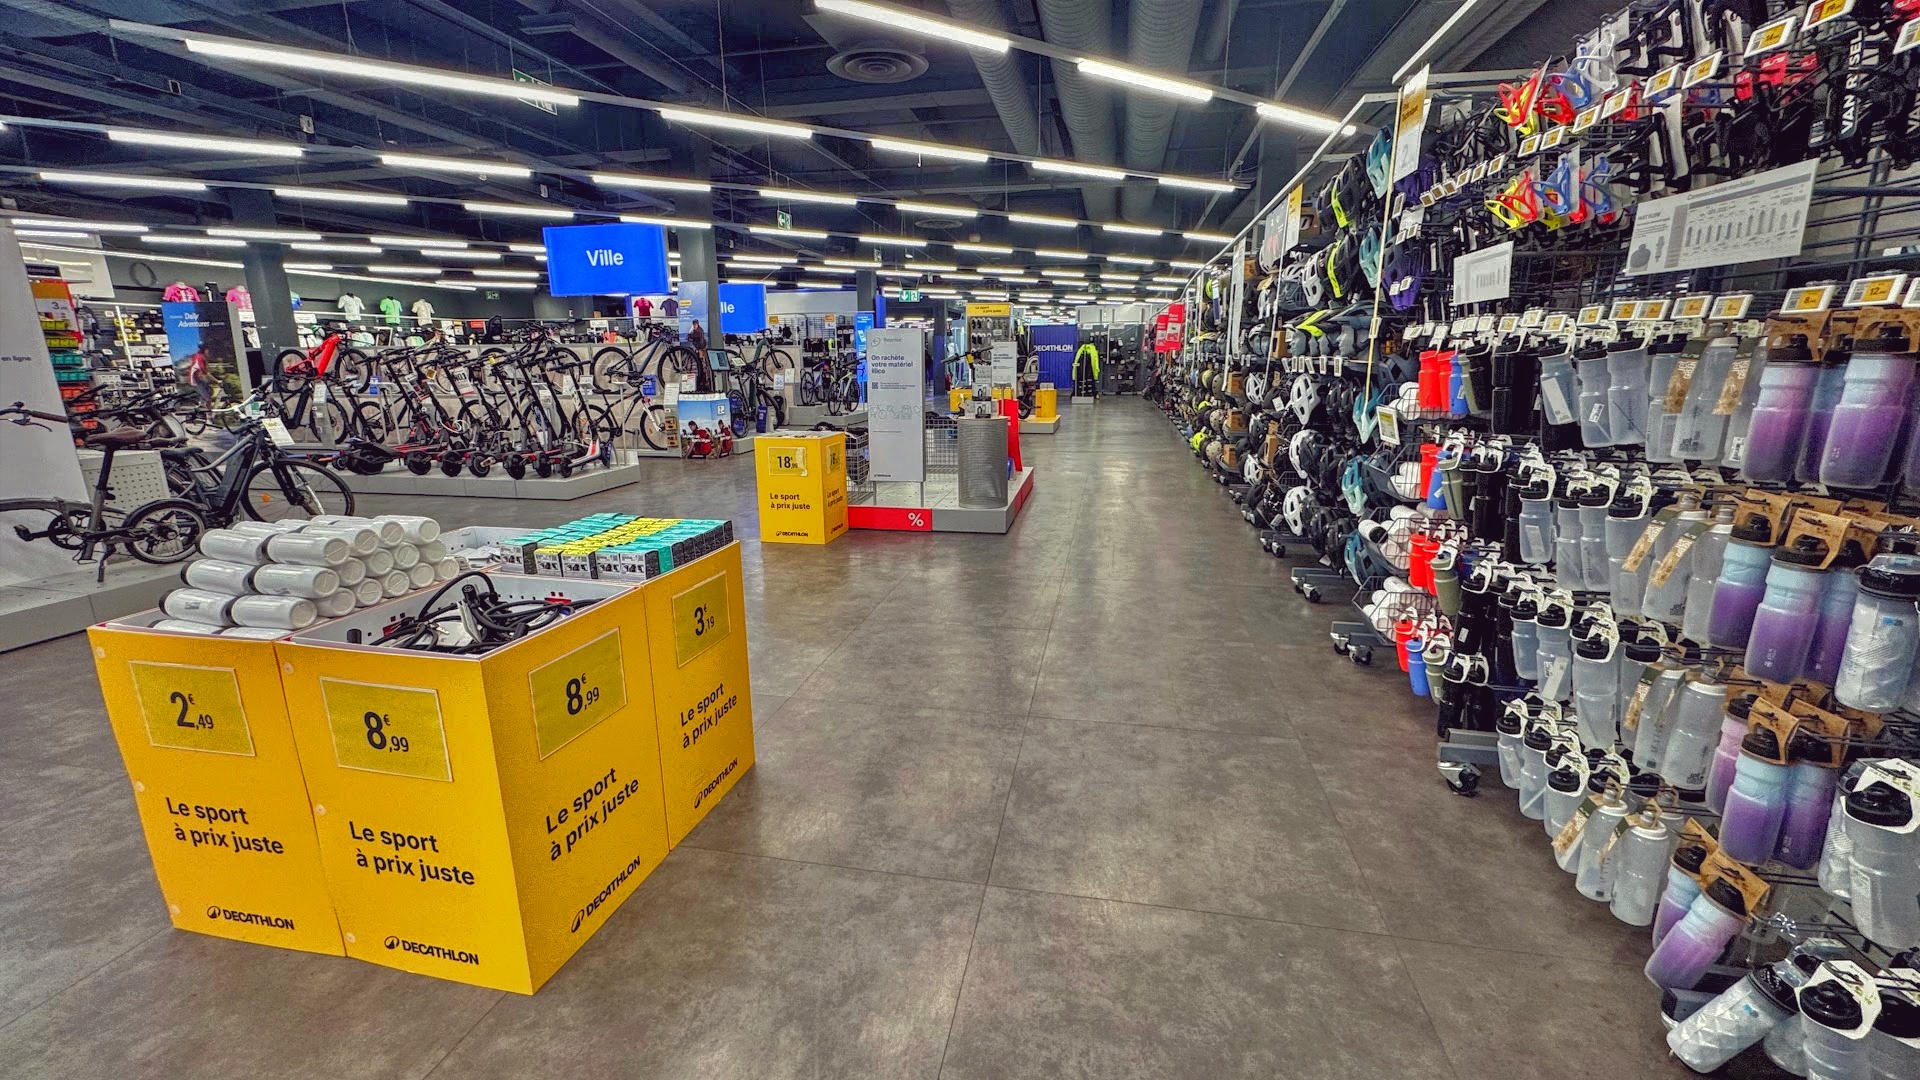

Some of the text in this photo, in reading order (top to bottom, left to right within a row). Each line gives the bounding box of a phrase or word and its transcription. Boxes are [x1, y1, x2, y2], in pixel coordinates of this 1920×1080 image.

[1841, 94, 1856, 134] VAN
[586, 249, 624, 267] Ville
[184, 312, 200, 320] Daily
[720, 301, 735, 314] lle
[178, 320, 210, 328] Adventures
[12, 355, 32, 363] ligne
[776, 502, 791, 510] prix
[792, 502, 811, 511] juste
[908, 512, 924, 527] %
[680, 682, 725, 727] Le sport
[683, 694, 738, 749] à prix juste
[703, 757, 738, 799] DECATHLON
[166, 796, 250, 825] Le sport
[546, 768, 617, 835] Le sport
[551, 779, 639, 861] à prix juste
[174, 822, 285, 855] à prix juste
[349, 821, 440, 853] Le sport
[356, 848, 476, 886] à prix juste
[586, 855, 641, 917] DECATHLON
[222, 908, 296, 931] DECATHLON
[401, 939, 480, 966] DECATHLON
